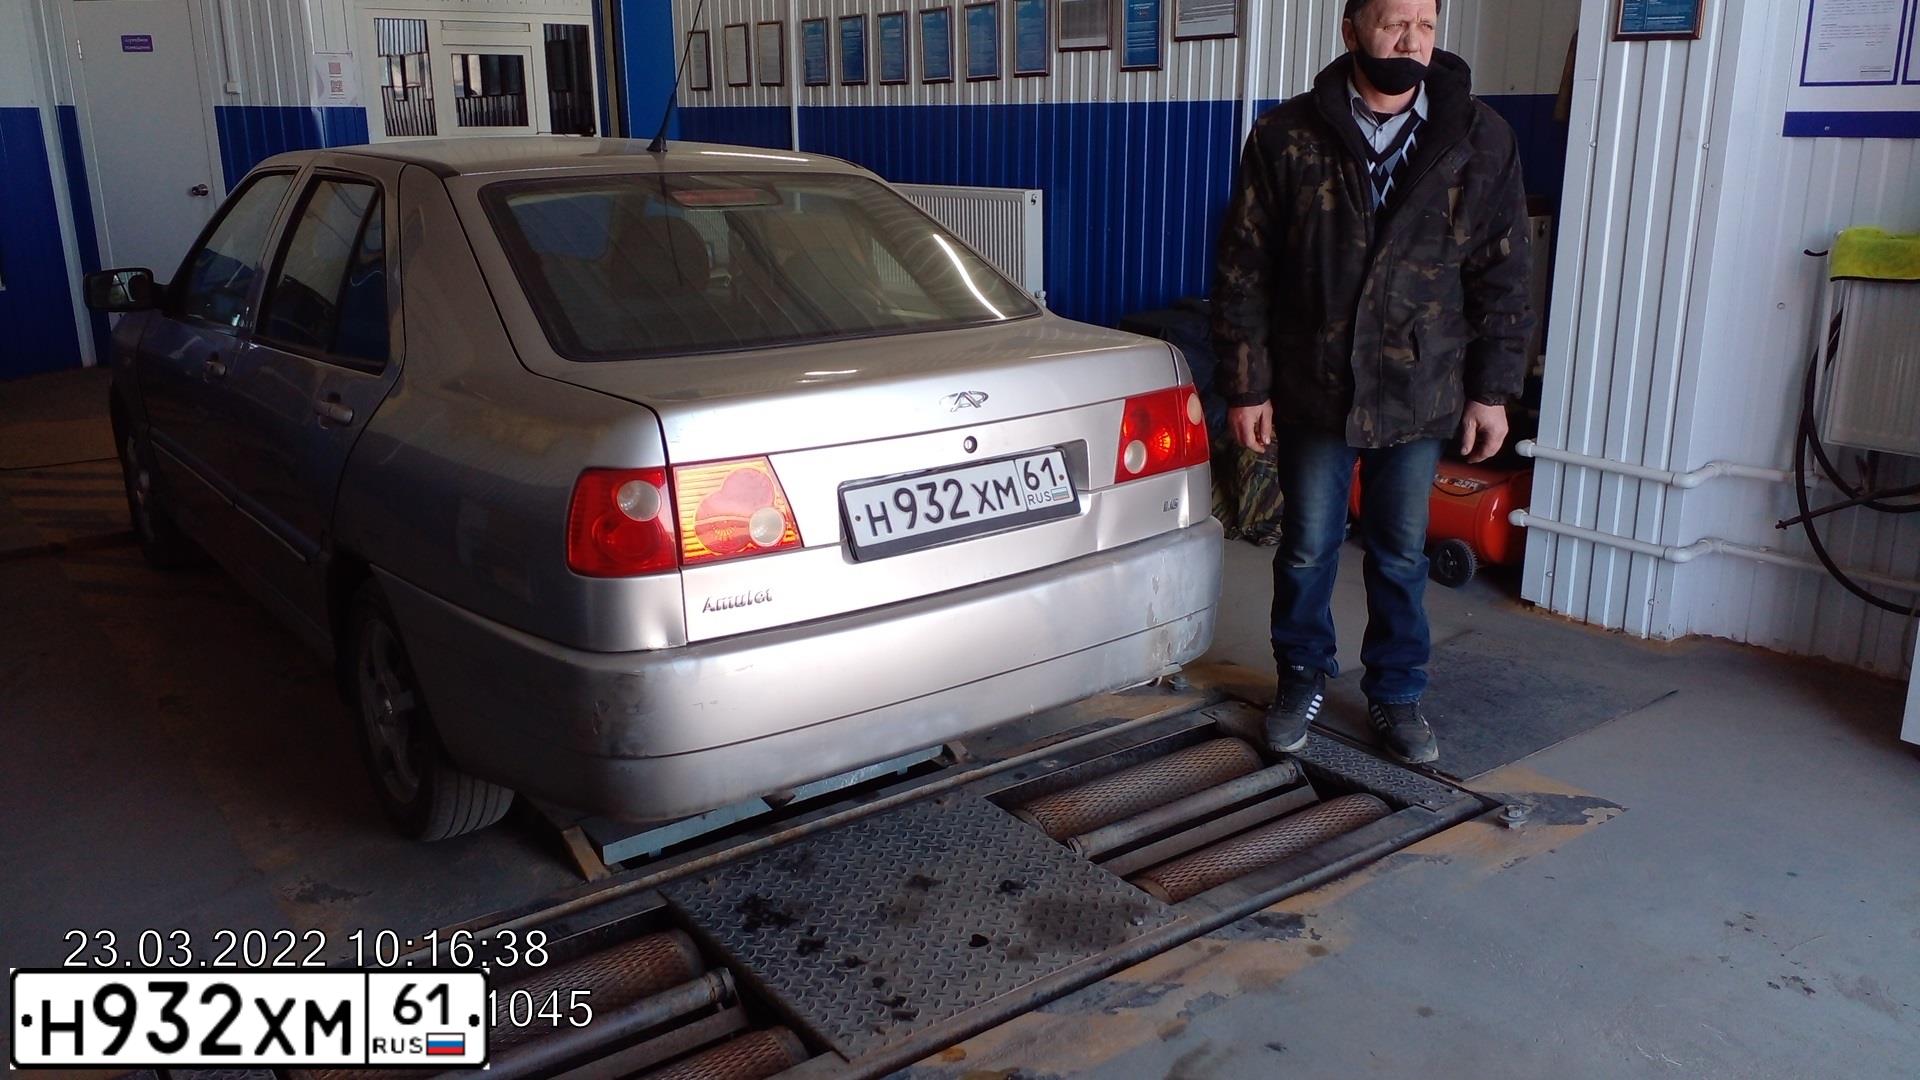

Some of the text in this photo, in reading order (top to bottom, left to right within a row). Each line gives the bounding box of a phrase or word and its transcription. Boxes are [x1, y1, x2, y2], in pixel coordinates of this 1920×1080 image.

[1024, 457, 1057, 491] 61
[1027, 491, 1051, 505] RUS
[702, 588, 772, 613] Amulet
